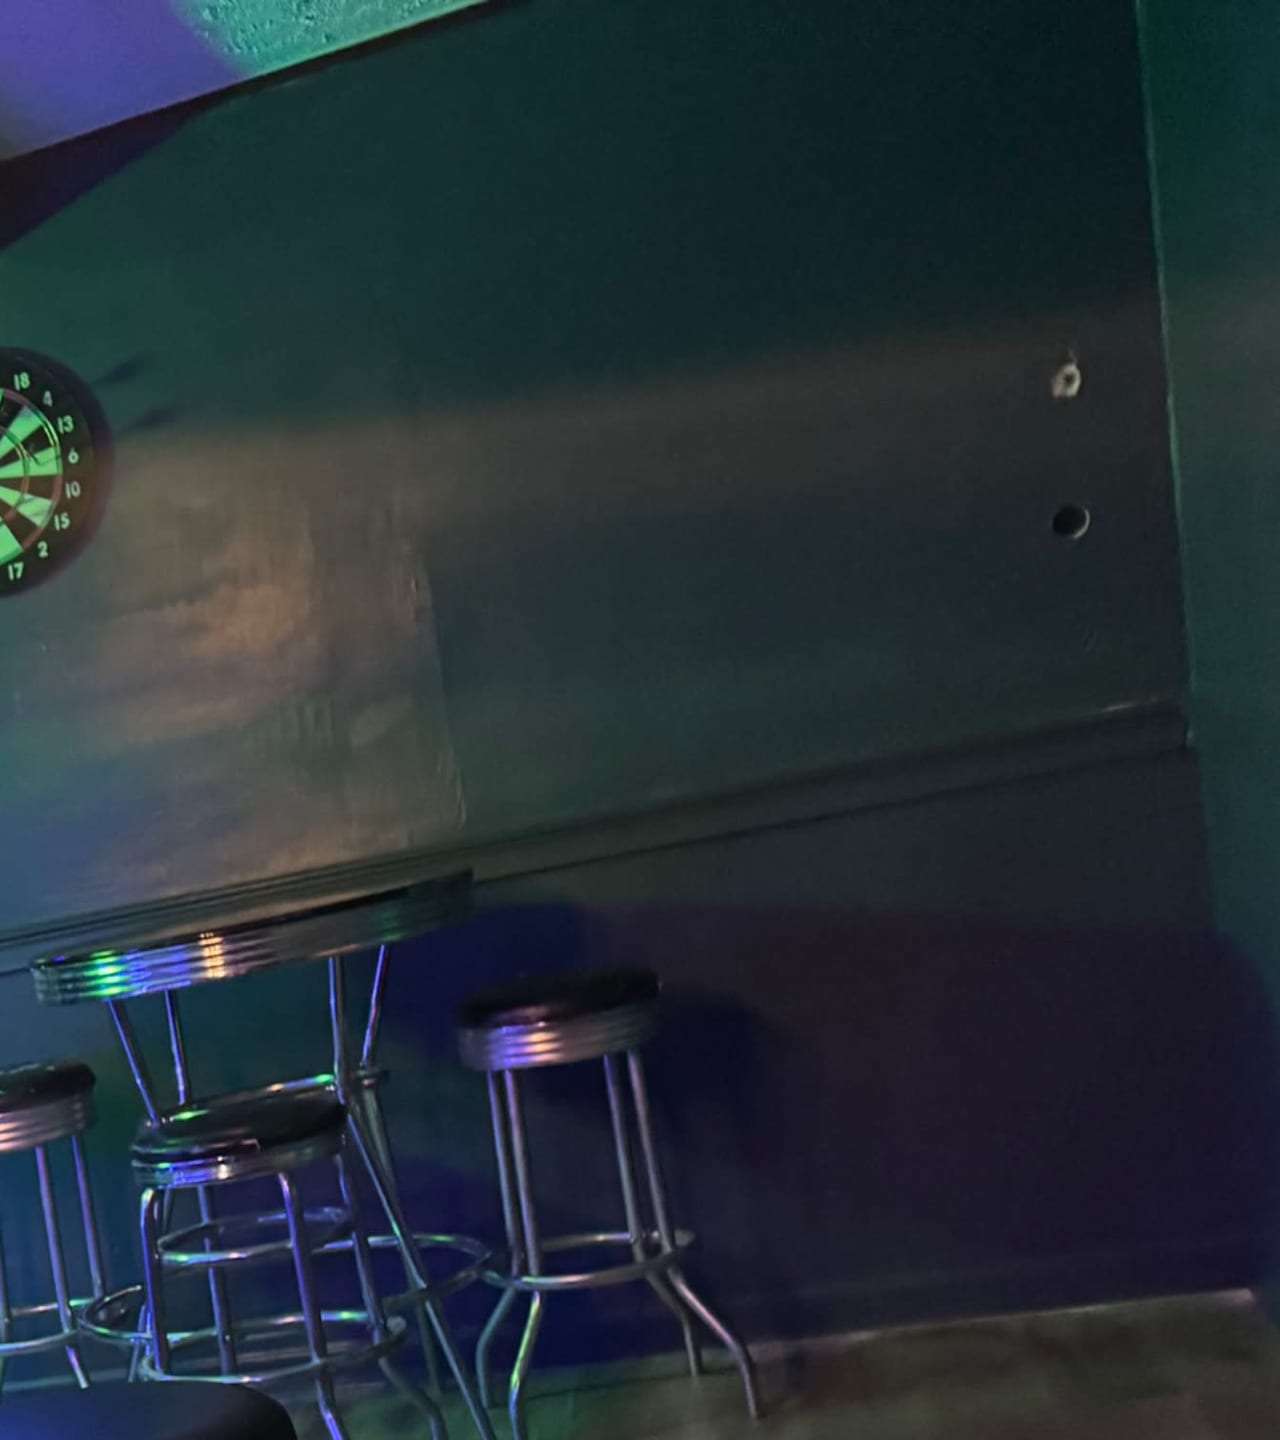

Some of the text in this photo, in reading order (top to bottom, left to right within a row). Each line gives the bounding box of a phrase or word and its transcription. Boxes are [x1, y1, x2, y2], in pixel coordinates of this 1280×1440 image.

[14, 373, 30, 390] 18
[43, 391, 53, 407] 4
[57, 415, 74, 434] 13
[68, 450, 79, 464] 6
[65, 481, 80, 498] 10
[54, 513, 70, 530] 15
[38, 542, 48, 557] 2
[8, 562, 23, 580] 17
